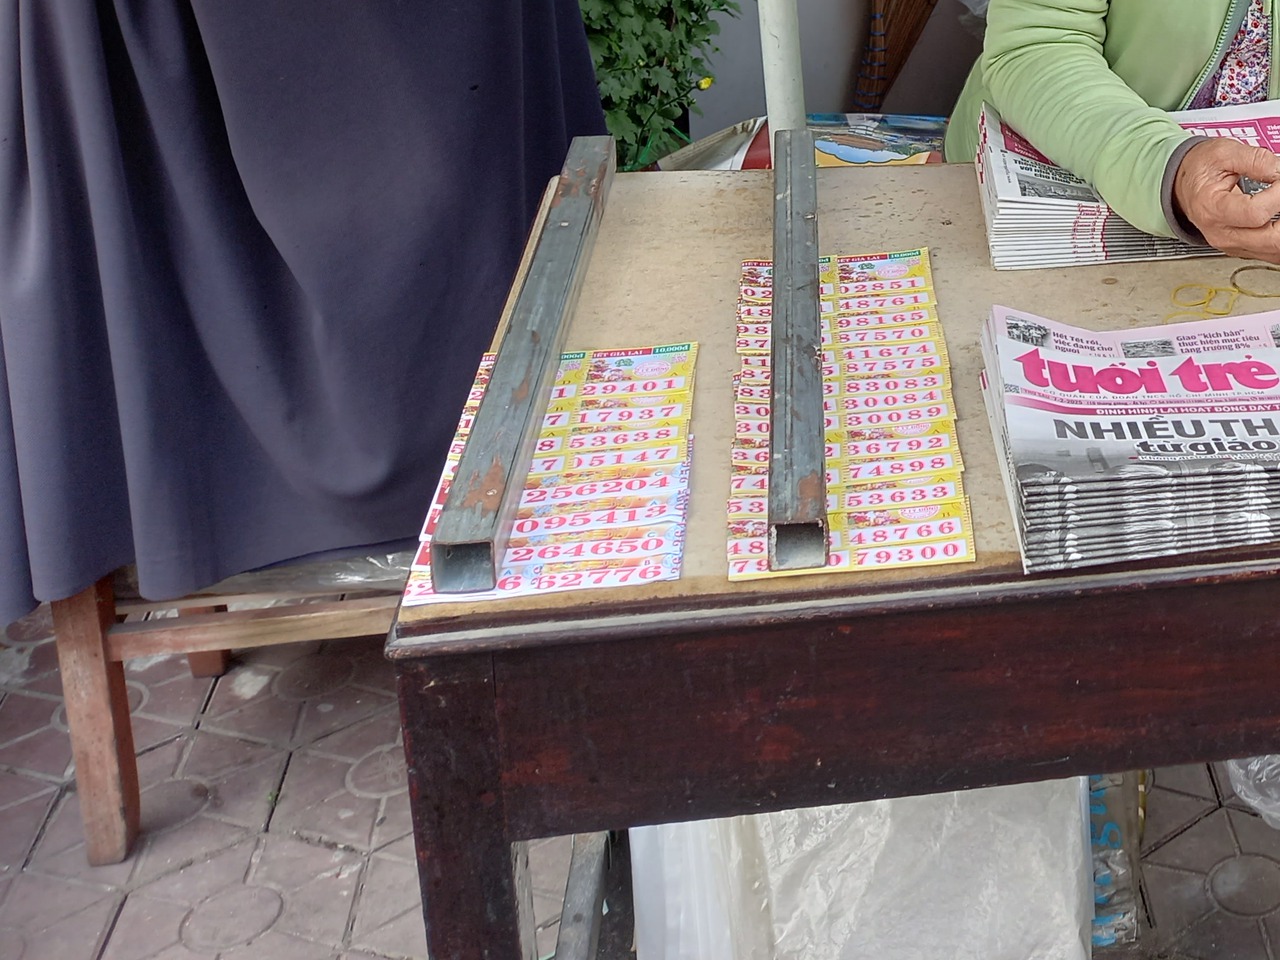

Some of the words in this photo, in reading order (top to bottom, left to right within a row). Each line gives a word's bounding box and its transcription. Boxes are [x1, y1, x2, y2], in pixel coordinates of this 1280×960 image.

[840, 295, 921, 310] 48761
[838, 312, 924, 328] 98165
[839, 328, 924, 343] 87570
[1176, 334, 1197, 342] Giao
[844, 344, 930, 360] 41674
[846, 357, 935, 373] 87575
[1014, 347, 1170, 397] tuổi
[1168, 353, 1280, 394] trẻ
[582, 378, 677, 396] 29401
[846, 376, 938, 393] 83083
[844, 391, 937, 410] 30084
[578, 406, 677, 424] 17937
[847, 406, 942, 426] 30089
[1052, 413, 1207, 441] NHIỀU
[569, 428, 672, 449] 53638
[847, 437, 943, 456] 36792
[1137, 440, 1184, 454] từ
[1188, 437, 1277, 456] giáo
[849, 457, 946, 479] 74898
[526, 476, 671, 504] 256204
[847, 485, 949, 507] 53633
[515, 505, 668, 534] 095413
[850, 521, 955, 546] 48766
[509, 538, 664, 563] 264650
[856, 543, 959, 565] 79300
